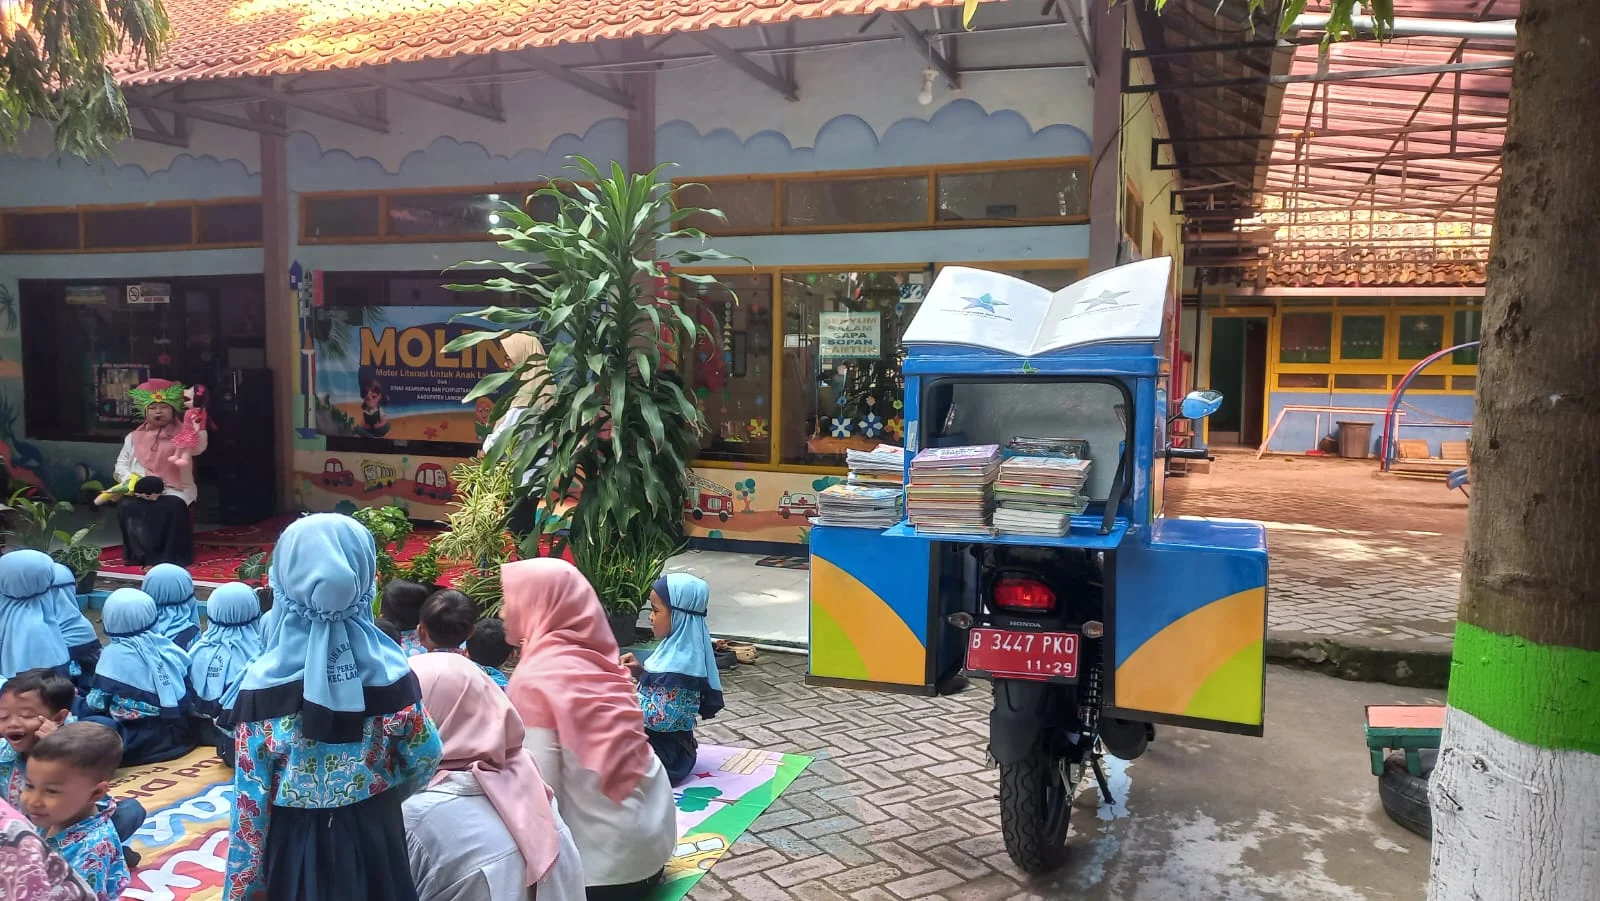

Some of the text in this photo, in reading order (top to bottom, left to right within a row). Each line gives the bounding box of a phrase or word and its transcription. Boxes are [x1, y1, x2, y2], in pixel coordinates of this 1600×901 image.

[360, 327, 505, 368] MOLIN
[376, 368, 398, 377] Motor
[400, 369, 429, 378] Literasi
[430, 370, 453, 378] Untuk
[455, 371, 475, 379] Anak
[1009, 620, 1041, 628] HONDA
[328, 642, 351, 663] DHAR
[972, 632, 982, 649] B
[991, 633, 1034, 653] 3447
